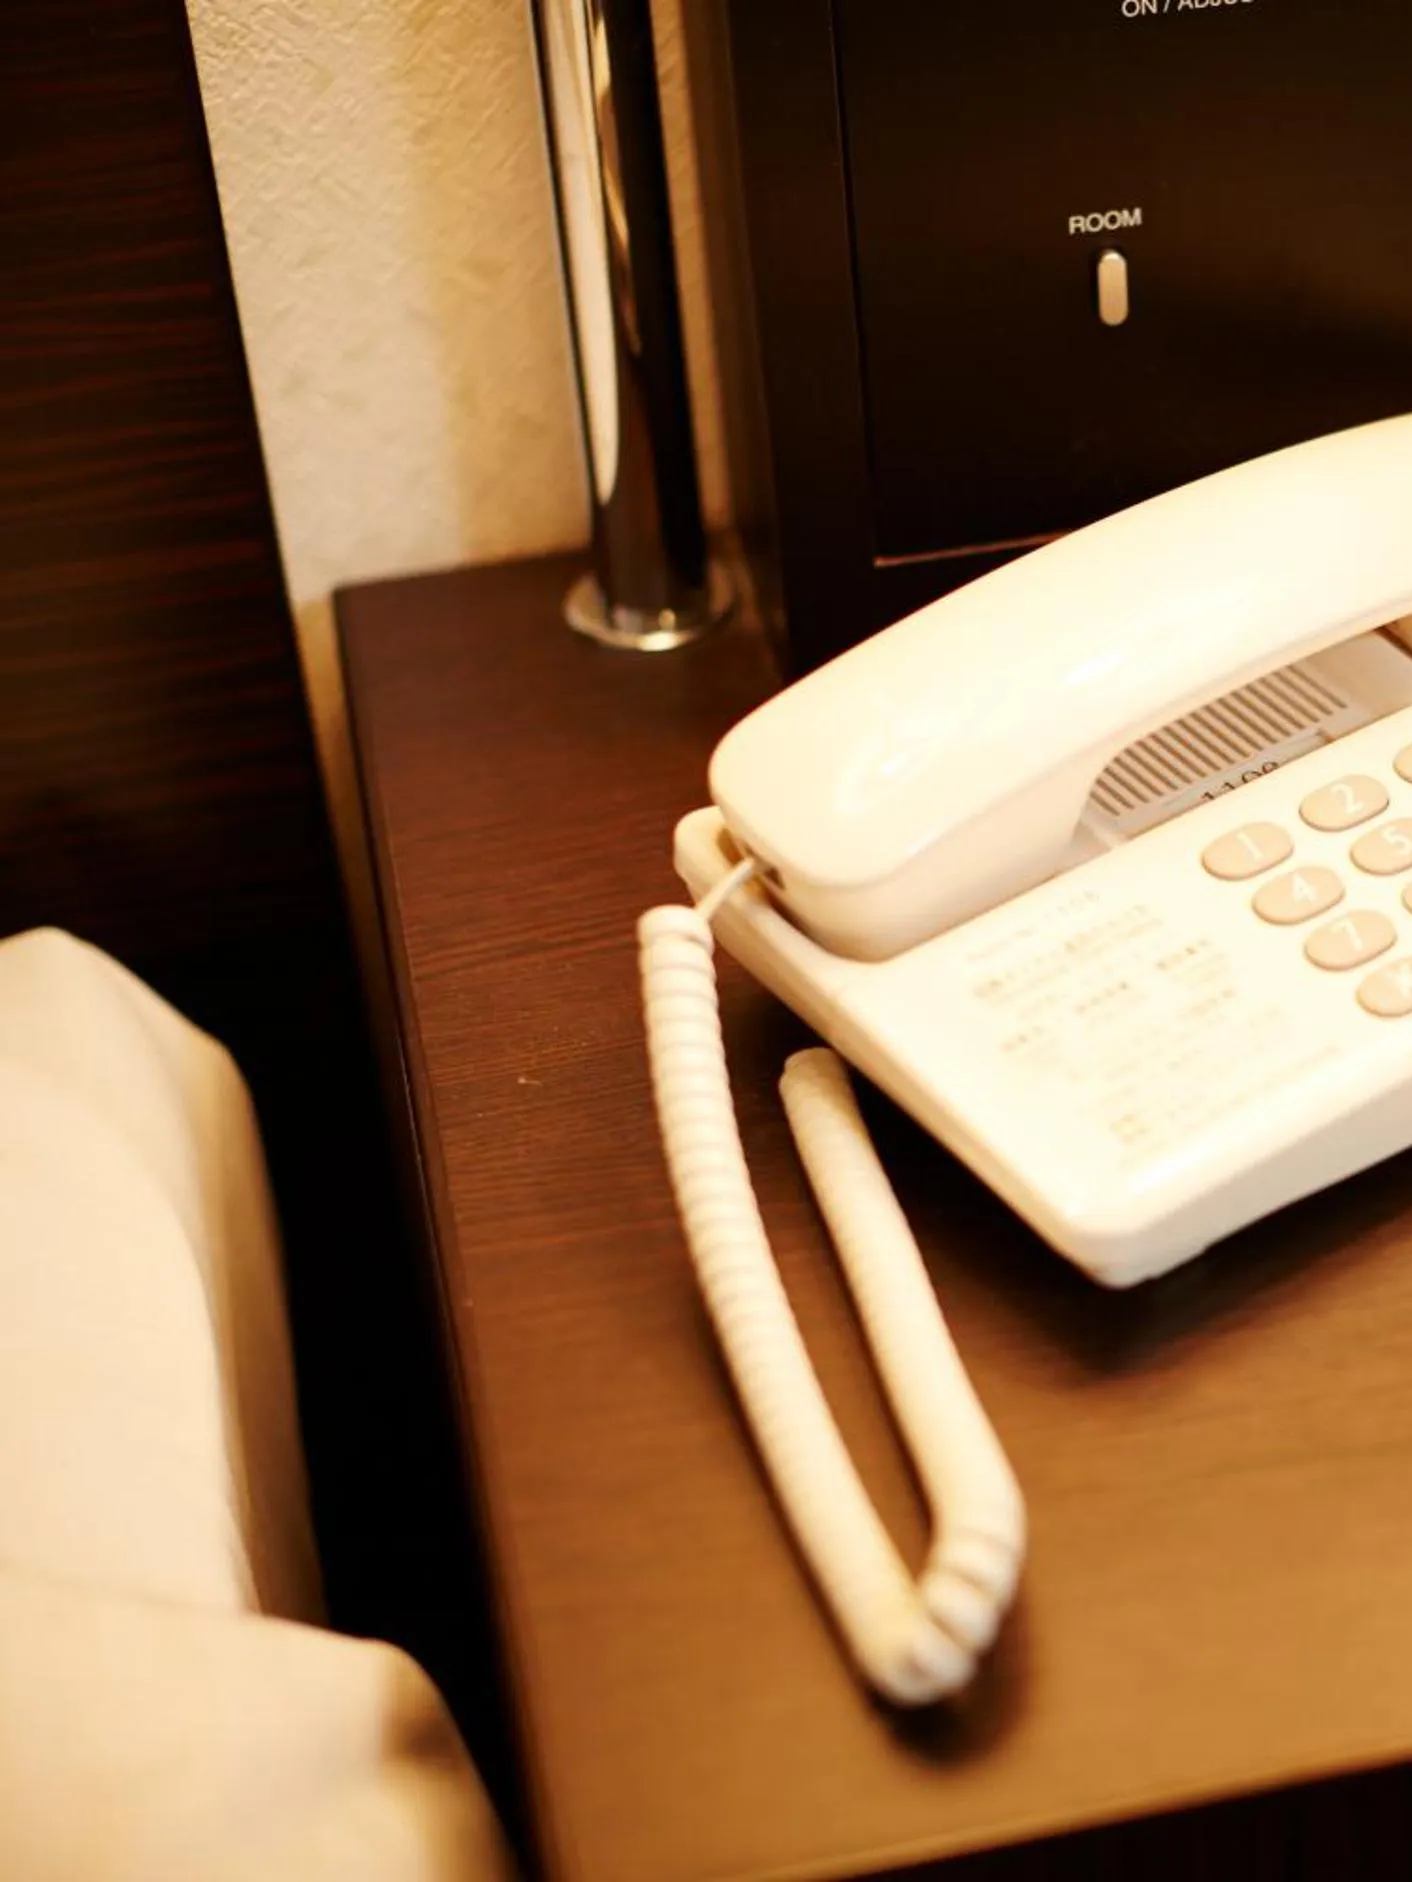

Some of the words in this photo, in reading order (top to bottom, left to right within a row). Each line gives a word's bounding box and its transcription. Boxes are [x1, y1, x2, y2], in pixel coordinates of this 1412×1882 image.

[1121, 0, 1158, 17] ON
[1068, 206, 1143, 235] ROOM
[1237, 832, 1262, 859] 1
[1330, 783, 1361, 813] 2
[1290, 874, 1317, 904] 4
[1381, 825, 1412, 855] 5
[1331, 919, 1364, 951] 7
